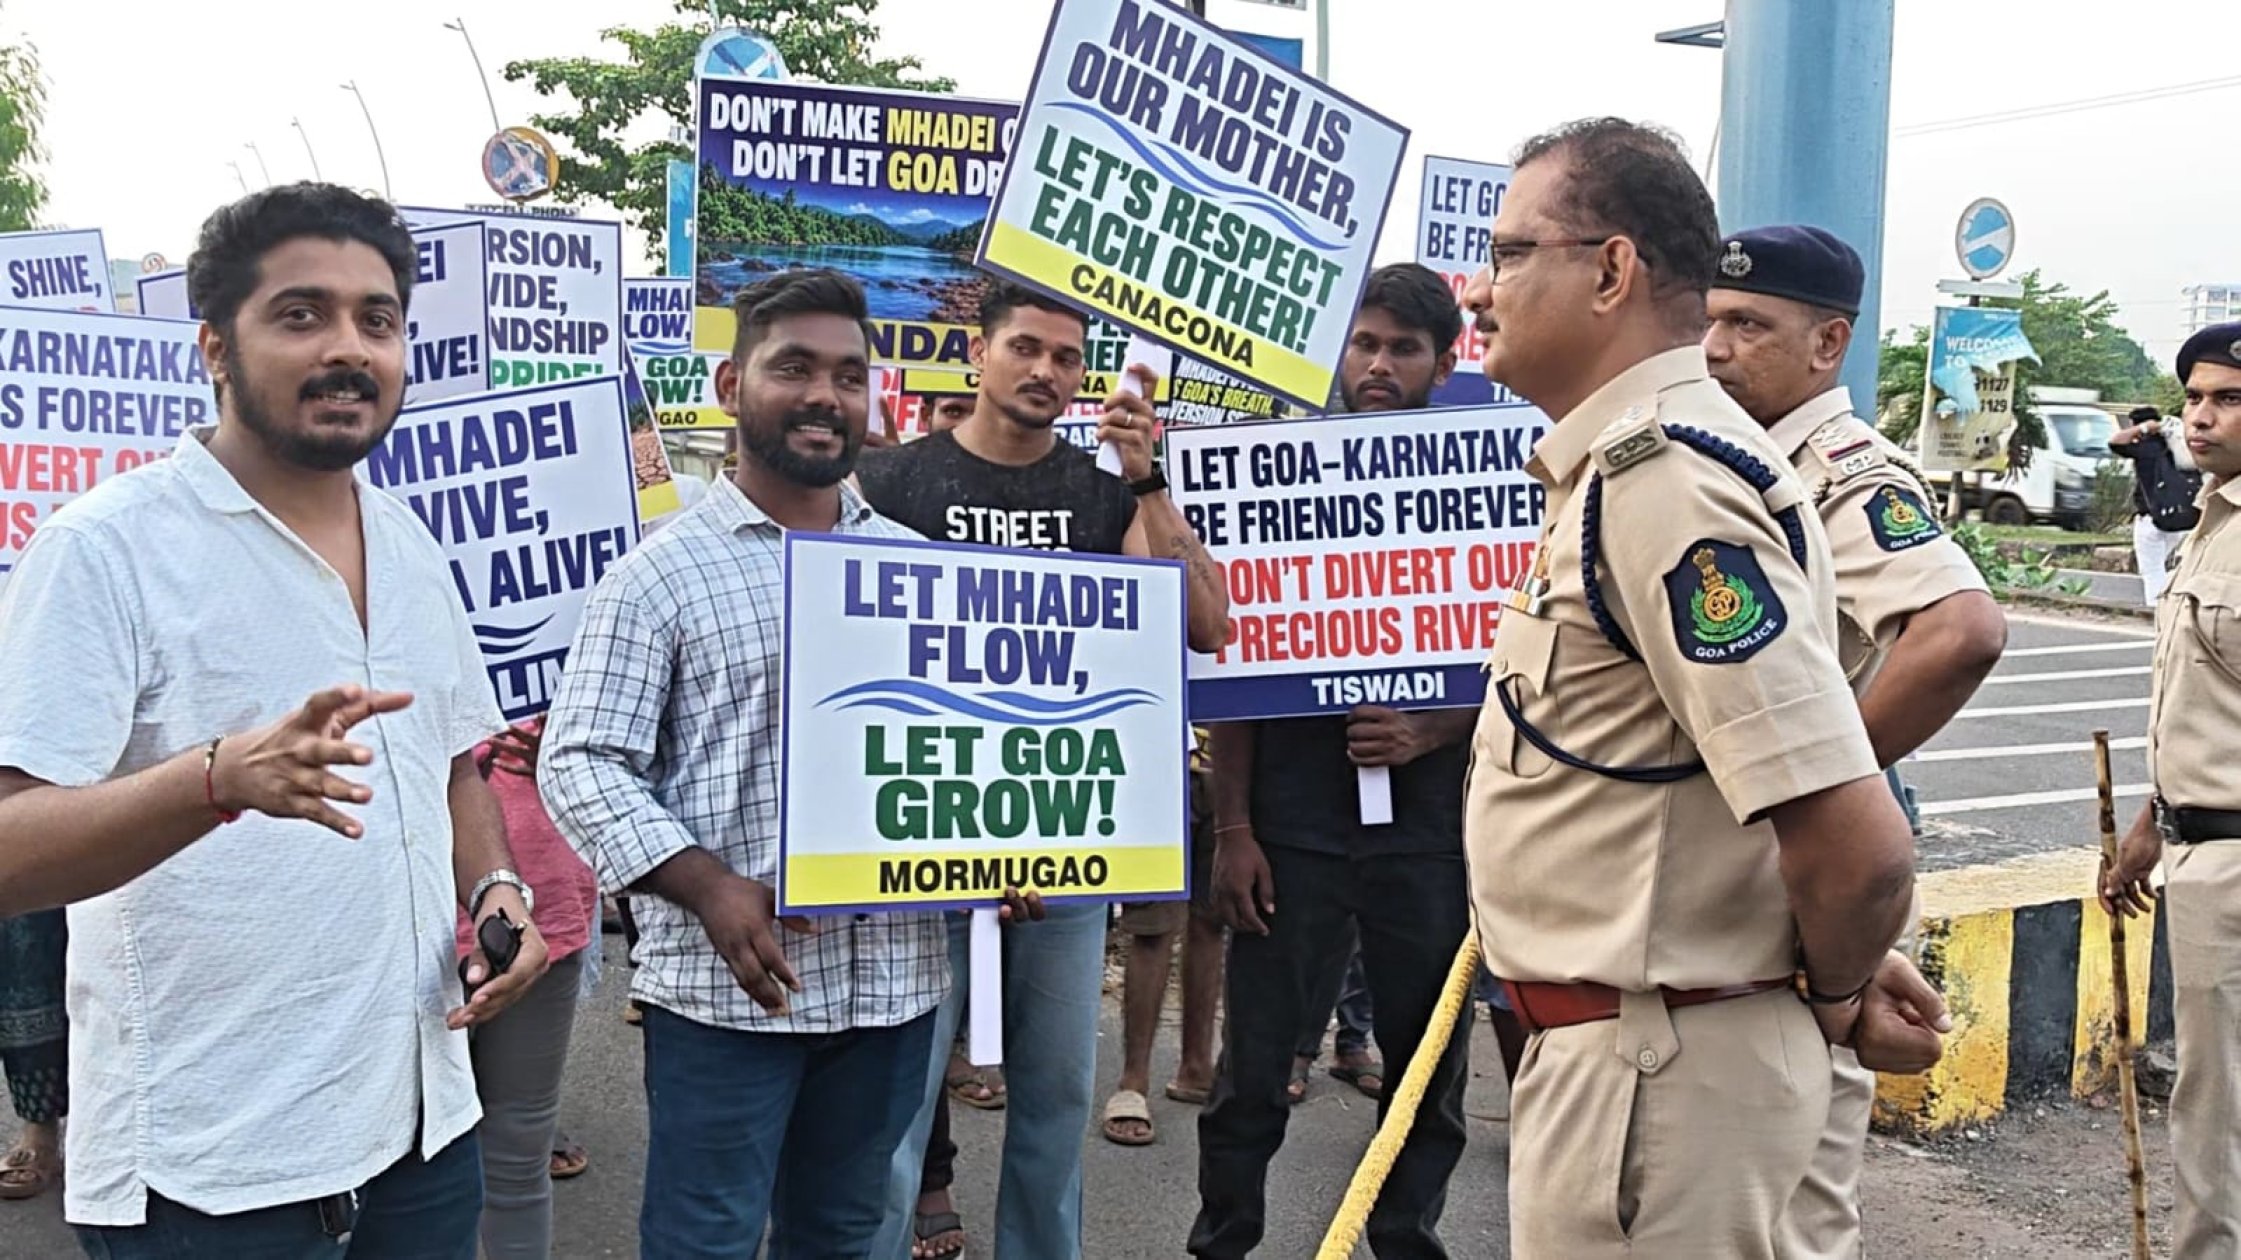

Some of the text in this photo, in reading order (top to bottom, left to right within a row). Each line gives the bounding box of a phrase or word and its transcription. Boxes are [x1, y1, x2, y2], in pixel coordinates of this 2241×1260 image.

[1109, 2, 1352, 163] MHADEI IS
[710, 92, 797, 136] DON'T
[801, 100, 881, 143] MAKE
[886, 107, 996, 154] MHADEI
[1067, 41, 1359, 238] OUR MOTHER,
[732, 139, 826, 183] DON'T
[830, 147, 884, 188] LET
[887, 151, 959, 195] GOA
[1430, 174, 1473, 215] LET
[1033, 124, 1343, 307] LET'S RESPECT
[1426, 221, 1457, 261] BE
[8, 254, 102, 299] SHINE,
[1029, 183, 1317, 355] EACH OTHER!
[1070, 263, 1255, 368] CANACONA
[646, 355, 709, 378] GOA
[368, 400, 579, 490] MHADEI
[1180, 445, 1240, 492] LET
[945, 505, 1073, 548] STREET
[1184, 502, 1229, 546] BE
[1238, 491, 1386, 546] FRIENDS
[844, 558, 1140, 631] LET MHADEI
[1323, 546, 1457, 600] DIVERT
[908, 623, 1089, 696] FLOW,
[1695, 617, 1778, 658] GOA POLICE
[1311, 671, 1446, 706] TISWADI
[865, 725, 1126, 776] LET GOA
[875, 778, 1116, 842] GROW!
[878, 853, 1108, 894] MORMUGAO
